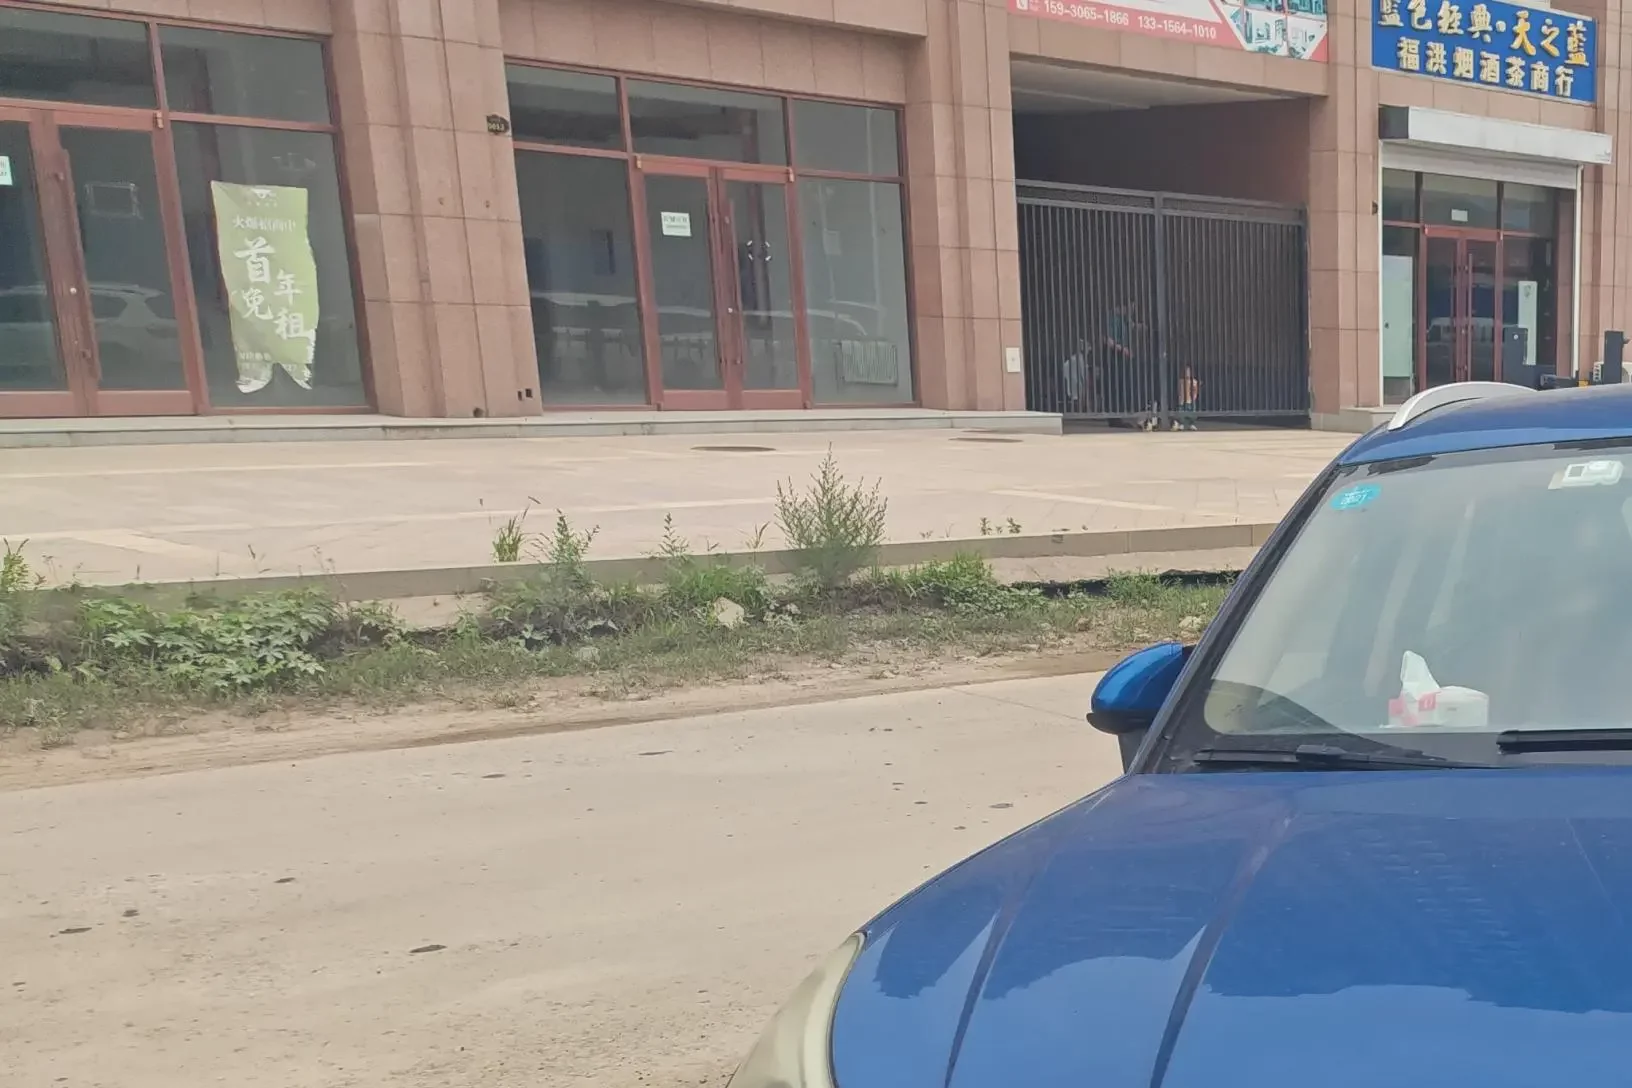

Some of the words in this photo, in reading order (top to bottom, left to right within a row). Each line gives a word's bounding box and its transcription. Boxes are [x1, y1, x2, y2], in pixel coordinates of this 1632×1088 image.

[1043, 0, 1130, 27] 159-3065-1866
[1137, 14, 1217, 39] 133-1564-1010
[1397, 36, 1574, 97] 福洪烟酒茶商行
